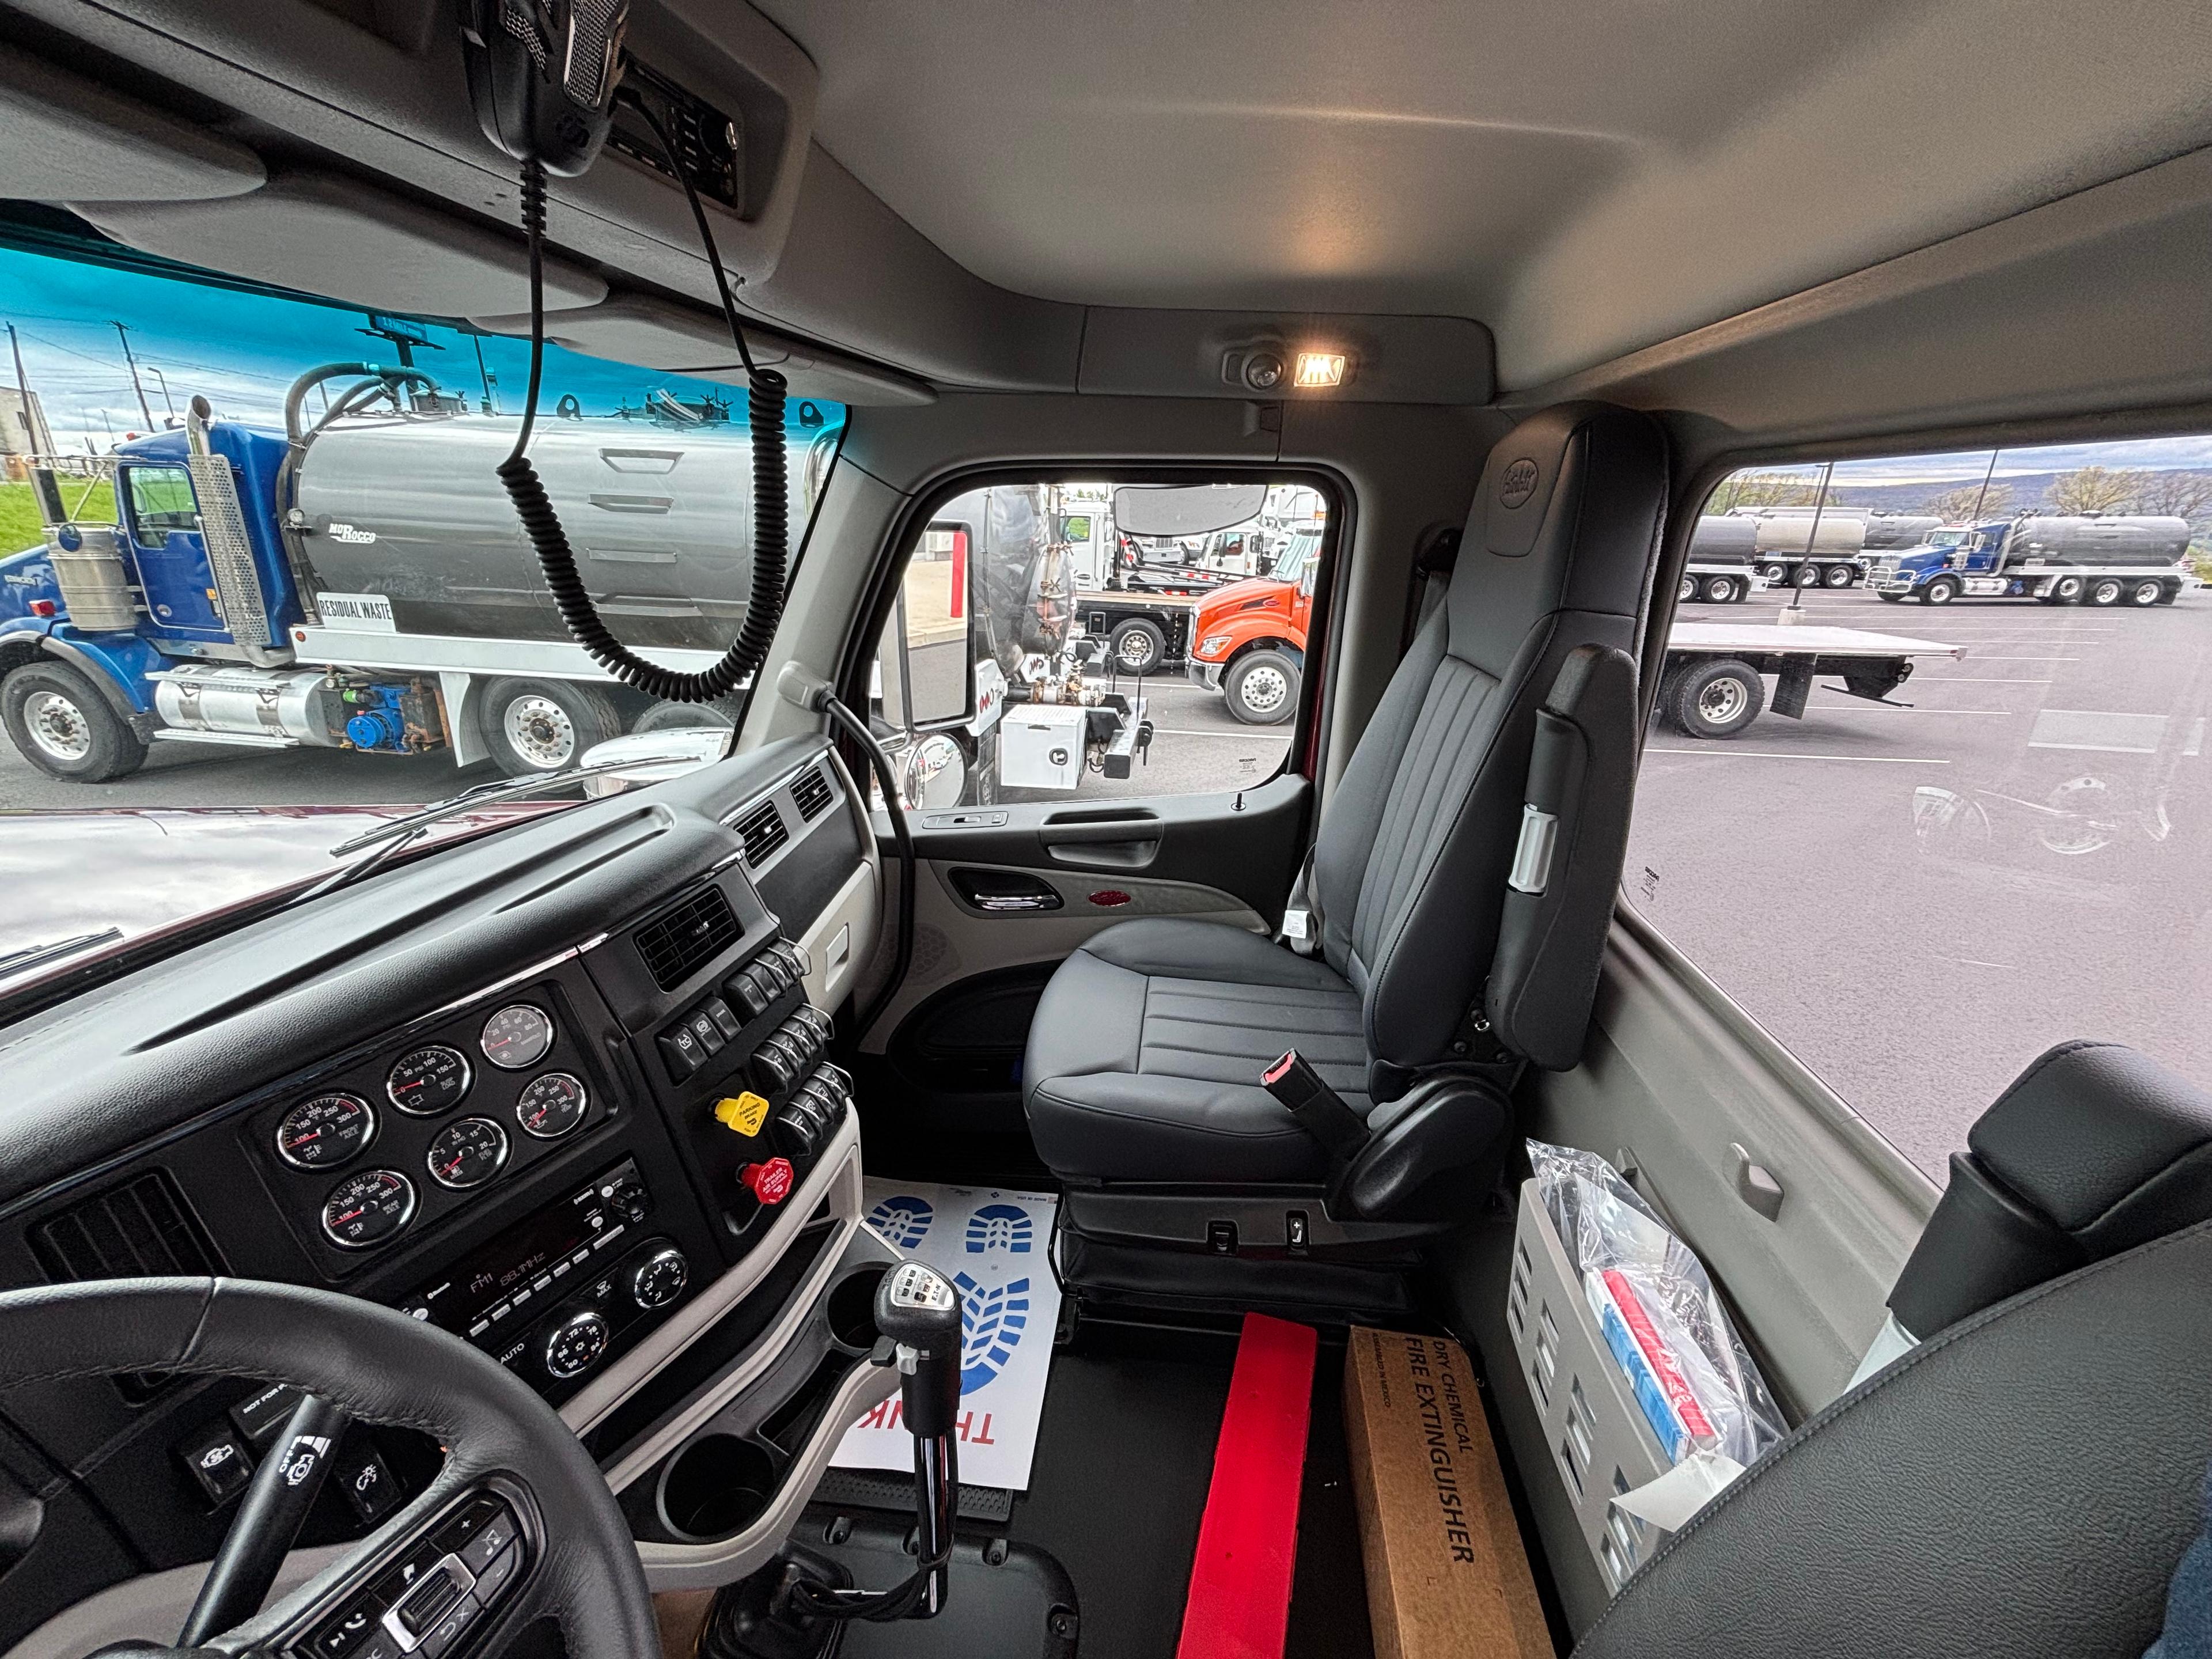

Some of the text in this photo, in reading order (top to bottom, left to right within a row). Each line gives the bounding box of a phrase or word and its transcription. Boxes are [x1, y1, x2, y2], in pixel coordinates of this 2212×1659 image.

[319, 600, 392, 619] RESIDUAL WASTE
[491, 1028, 499, 1036] 20
[681, 1037, 691, 1046] TC
[423, 1057, 436, 1066] 100
[403, 1069, 413, 1077] 50
[436, 1065, 449, 1074] 150
[533, 1085, 545, 1095] 200
[548, 1085, 559, 1094] 250
[525, 1099, 536, 1108] 150
[556, 1095, 567, 1105] 300
[306, 1107, 322, 1118] 200
[323, 1105, 338, 1117] 250
[739, 1103, 760, 1116] PARKING
[336, 1112, 351, 1123] 300
[296, 1119, 311, 1130] 150
[469, 1130, 479, 1138] 15
[479, 1141, 488, 1149] 20
[763, 1169, 787, 1192] AIR SUPPLY
[764, 1167, 783, 1183] TRAILER
[350, 1184, 365, 1195] 200
[366, 1181, 380, 1193] 250
[379, 1188, 393, 1199] 300
[340, 1196, 354, 1207] 150
[470, 1273, 493, 1293] FM1
[597, 1284, 612, 1297] MAX
[569, 1328, 579, 1338] 72
[588, 1326, 597, 1335] 78
[501, 1343, 525, 1364] AUTO
[558, 1348, 569, 1358] 66
[568, 1359, 578, 1369] 60
[1381, 1380, 1391, 1408] MEXICO
[1433, 1340, 1474, 1453] DRY CHEMICAL
[243, 1388, 279, 1414] NOT FOR
[857, 1400, 995, 1445] THNK
[1405, 1337, 1475, 1563] FIRE EXTINGUISHER
[279, 1449, 294, 1473] OFF
